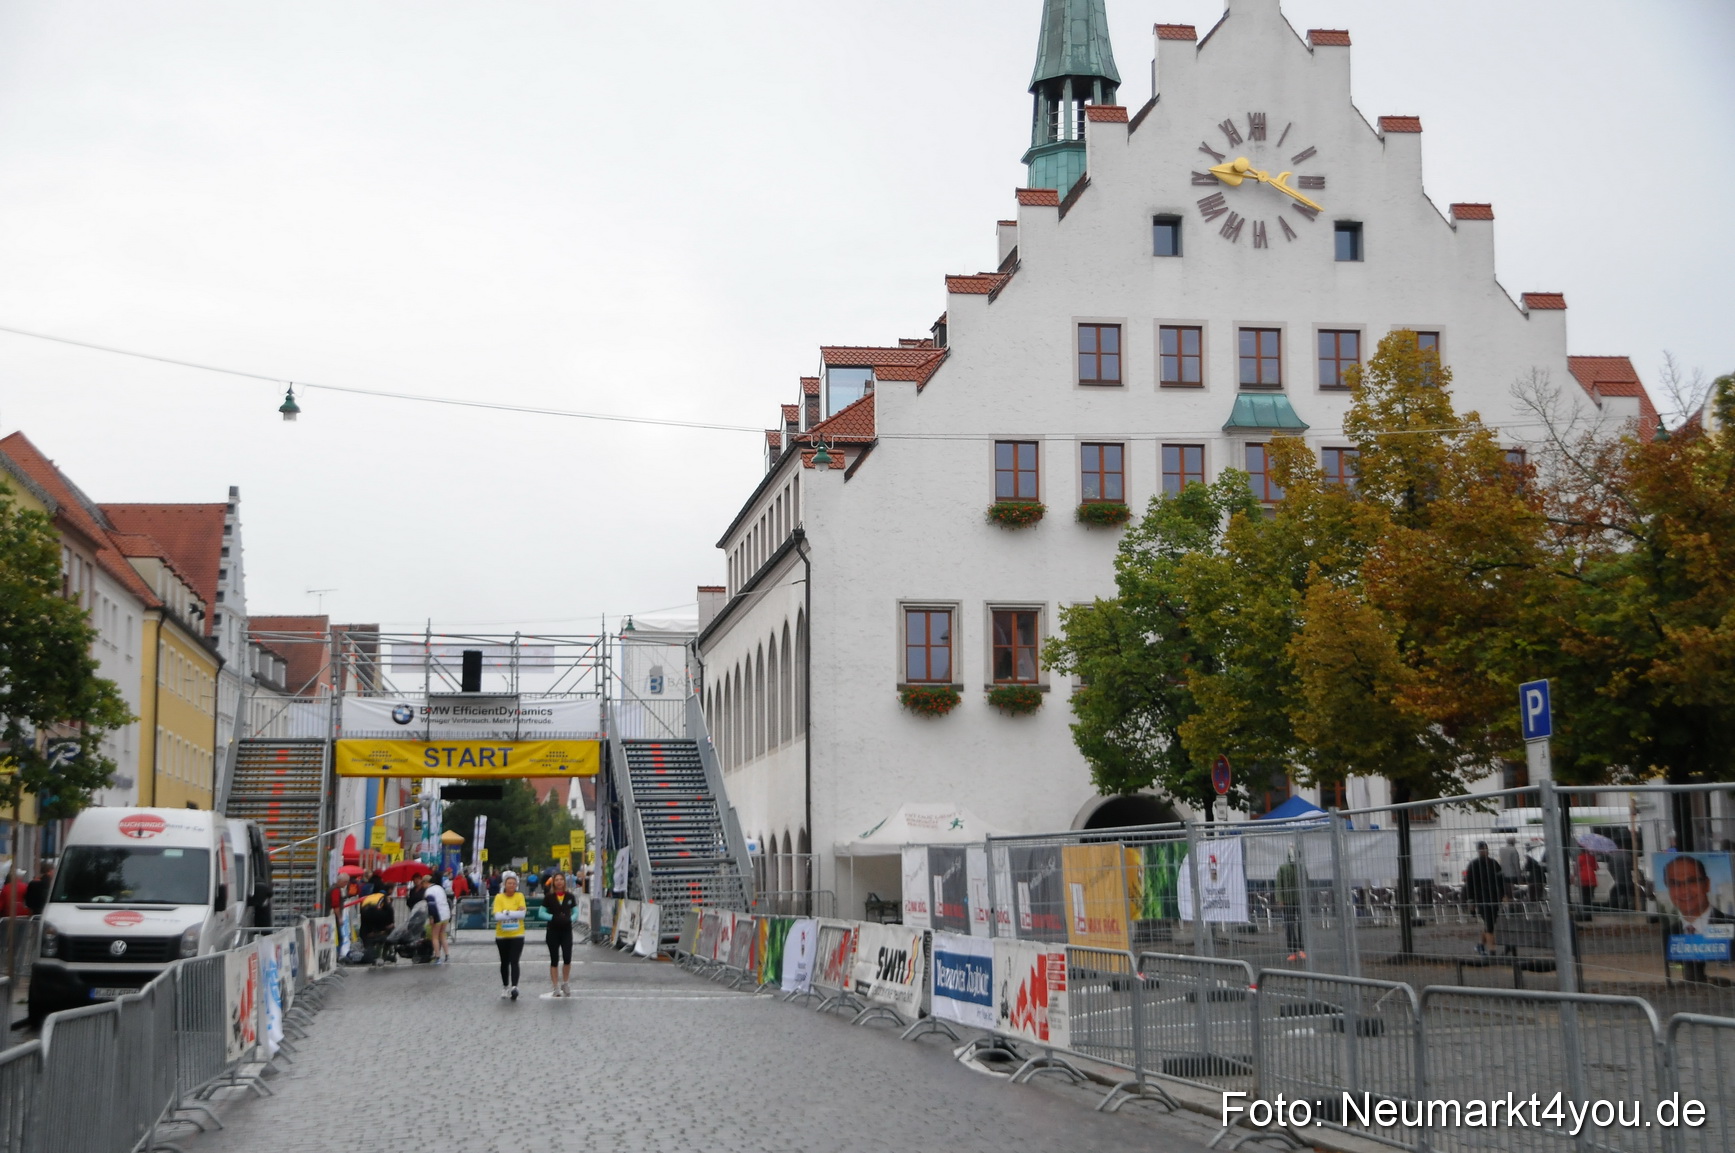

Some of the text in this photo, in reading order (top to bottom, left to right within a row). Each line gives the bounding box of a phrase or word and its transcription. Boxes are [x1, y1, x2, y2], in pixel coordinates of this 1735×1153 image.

[1218, 118, 1243, 148] XI
[1247, 112, 1266, 141] XII
[1198, 141, 1226, 164] X
[1291, 145, 1317, 166] II
[1298, 175, 1325, 190] III
[1196, 191, 1229, 224] VIII
[1219, 211, 1245, 243] VII
[1253, 220, 1268, 249] VI
[1278, 215, 1297, 242] V
[420, 706, 553, 718] BMW EfficientDynamics
[1526, 689, 1544, 732] P
[424, 747, 514, 768] START
[1670, 940, 1727, 954] FÜRACKER
